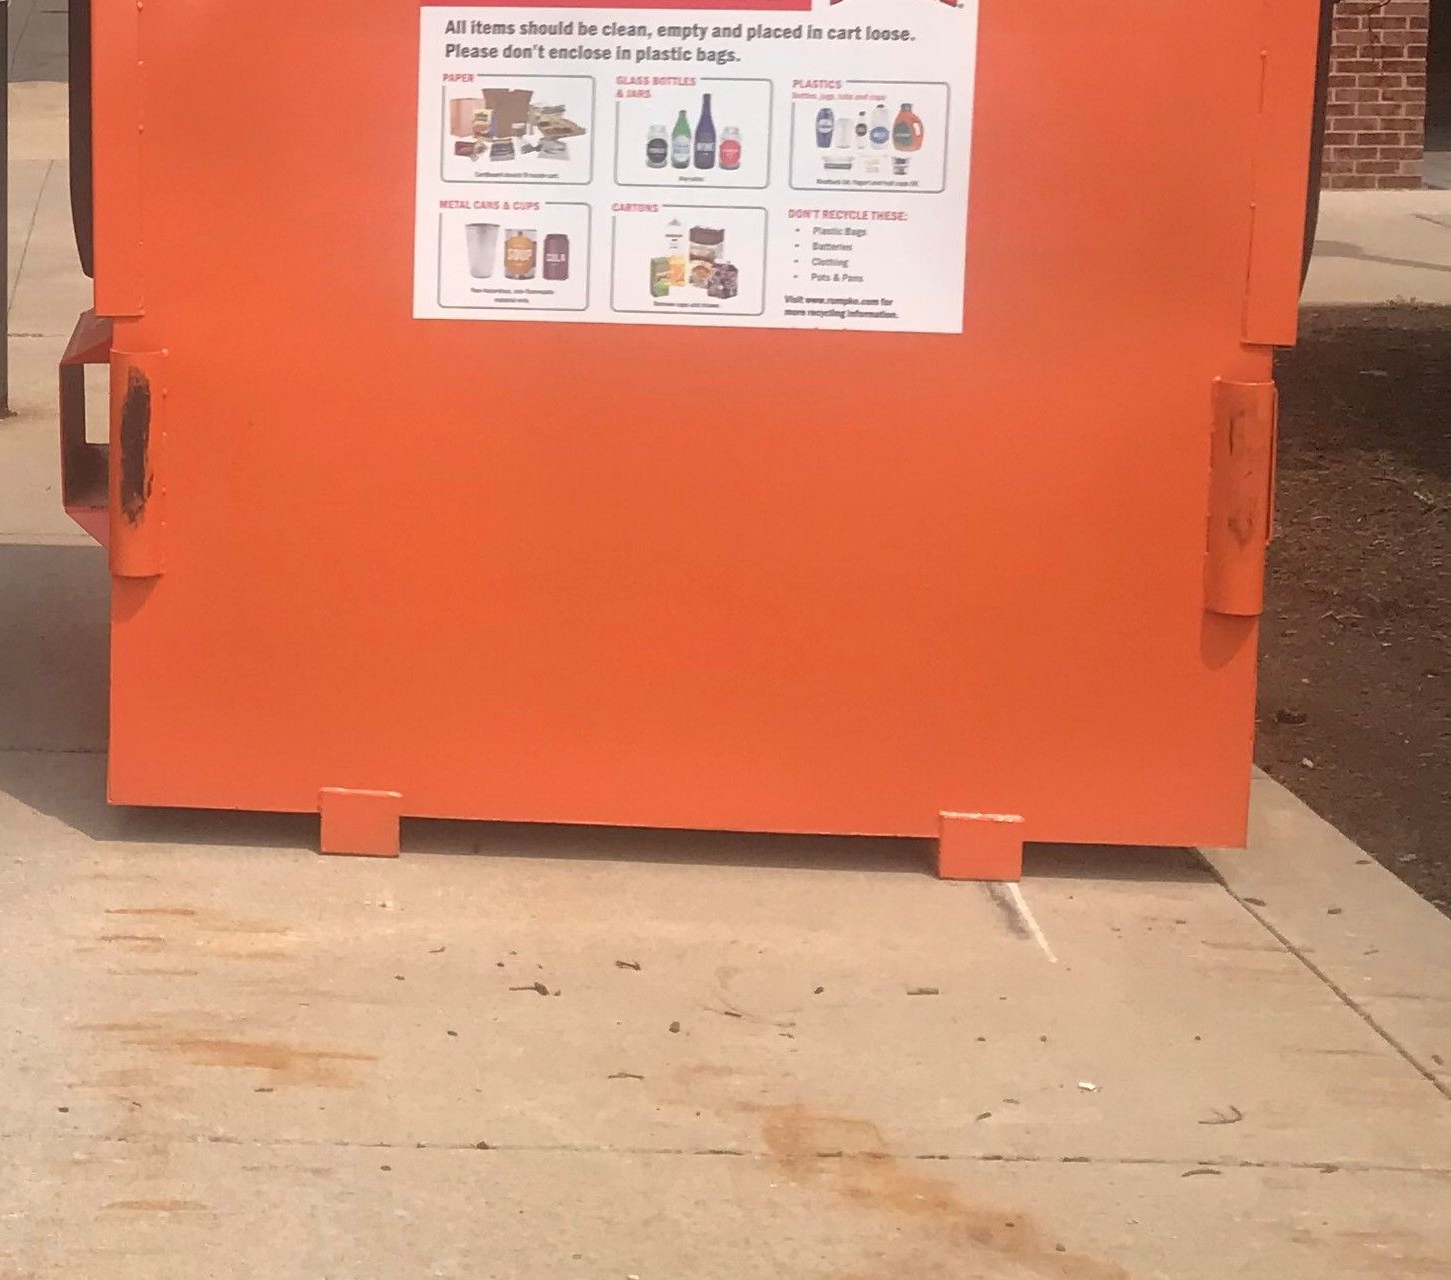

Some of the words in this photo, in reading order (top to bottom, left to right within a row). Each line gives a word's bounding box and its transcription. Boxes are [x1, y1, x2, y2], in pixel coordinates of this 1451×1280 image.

[445, 19, 466, 35] All
[471, 20, 515, 35] items
[519, 20, 573, 36] should
[578, 21, 598, 36] be
[602, 21, 652, 39] clean,
[657, 24, 708, 40] empty
[711, 24, 742, 38] and
[747, 24, 802, 41] placed
[807, 25, 823, 40] in
[827, 26, 861, 40] cart
[866, 25, 915, 41] loose.
[445, 44, 498, 58] Please
[503, 44, 545, 59] don't
[550, 45, 611, 60] enclose
[616, 46, 631, 60] in
[635, 47, 692, 64] plastic
[696, 48, 741, 65] bags.
[442, 73, 475, 82] PAPER
[616, 76, 649, 85] GLASS
[652, 76, 696, 86] BOTTLES
[792, 80, 842, 89] PLASTICS
[439, 200, 470, 209] METAL
[473, 201, 500, 210] CANS
[513, 201, 540, 210] CUPS
[612, 203, 659, 212] CARTONS
[788, 209, 819, 219] DON'T
[822, 210, 869, 220] RECYCLE
[871, 211, 908, 221] THESE:
[813, 227, 843, 235] Plastic
[844, 227, 866, 238] Bags
[811, 257, 849, 268] Clothing
[784, 295, 804, 304] Visit
[881, 298, 893, 306] for
[807, 308, 845, 319] recycling
[847, 309, 899, 319] information.
